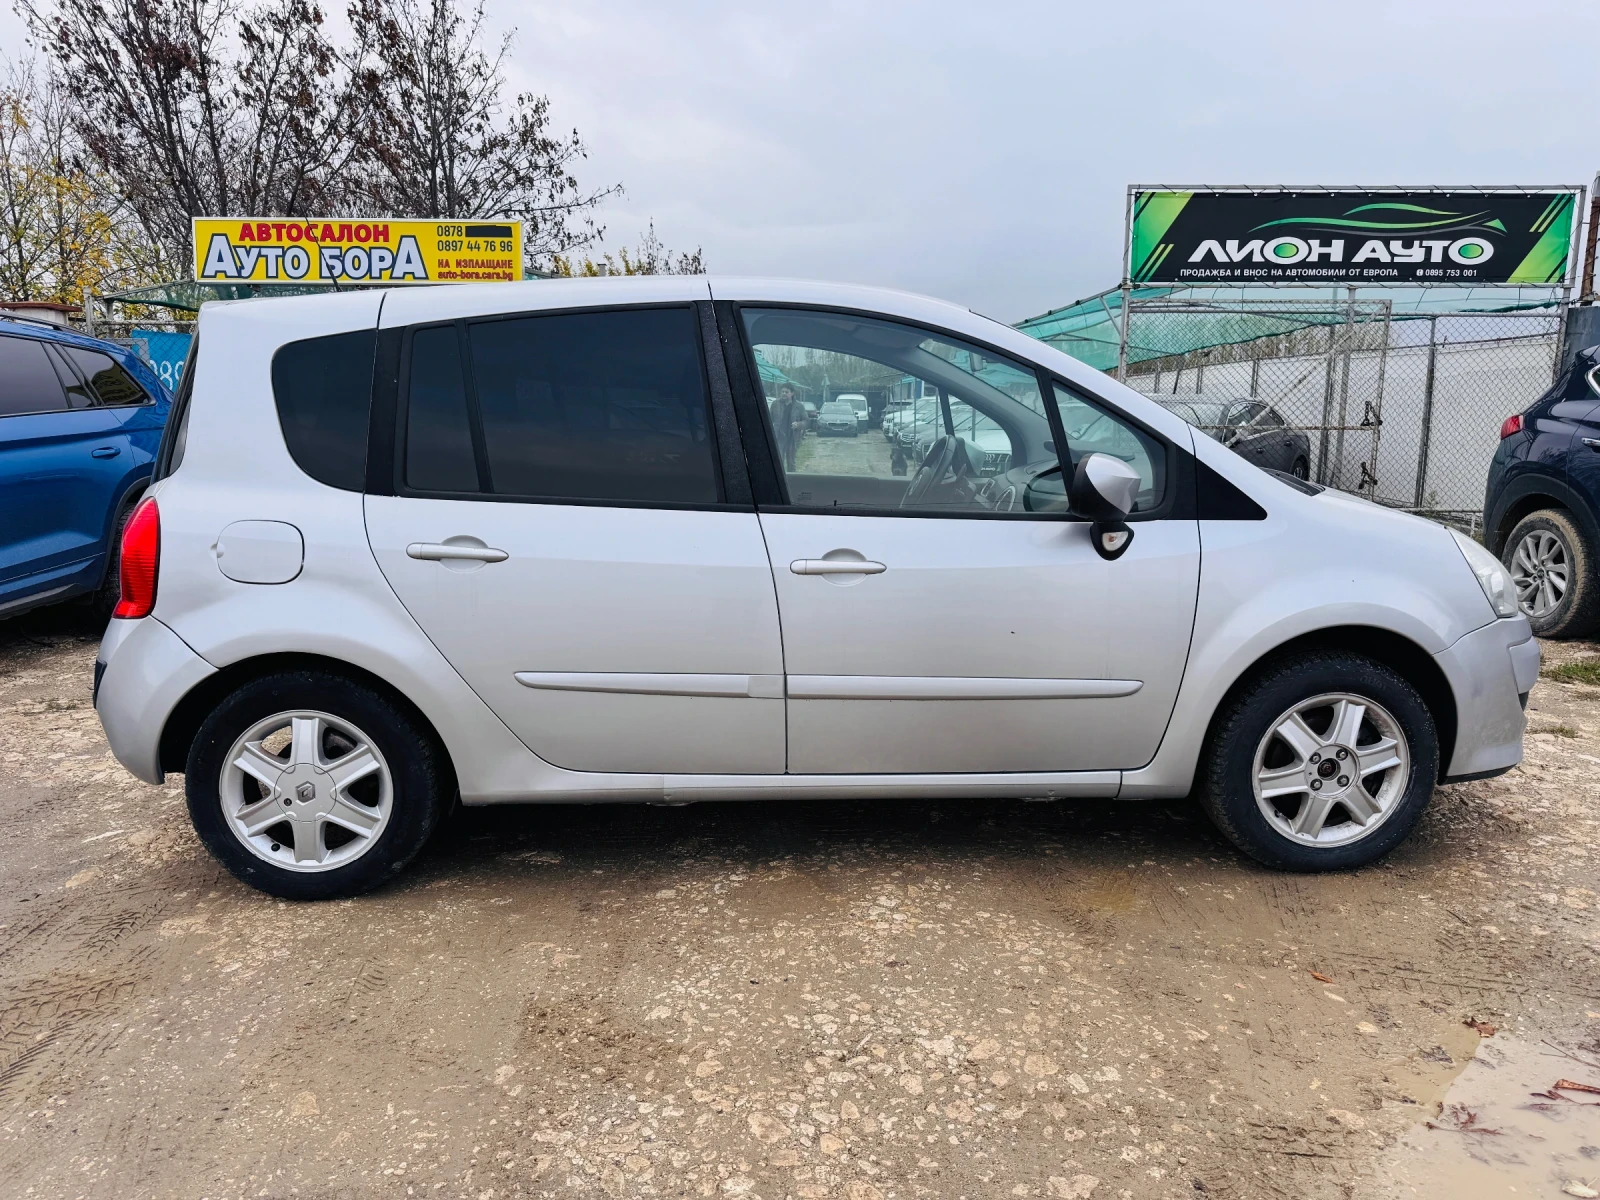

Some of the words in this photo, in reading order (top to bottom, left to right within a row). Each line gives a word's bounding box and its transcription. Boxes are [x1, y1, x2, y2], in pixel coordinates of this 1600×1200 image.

[238, 222, 390, 243] АВТОСАЛОН
[437, 225, 463, 237] 0878
[437, 240, 464, 252] 0897
[466, 240, 481, 252] 44
[483, 240, 496, 252] 76
[499, 240, 513, 252] 96
[1187, 236, 1345, 265] ЛИОН
[1350, 237, 1495, 265] АУТО
[438, 259, 450, 268] НА
[456, 259, 513, 269] ИЗПЛАЩАНЕ
[438, 270, 513, 281] auto-bora.cars.bg
[1180, 268, 1232, 277] ПРОДАЖБА
[1234, 268, 1241, 276] И
[1243, 268, 1269, 276] ВНОС
[1270, 268, 1283, 276] НА
[1285, 268, 1346, 276] АВТОМОБИЛИ
[1348, 268, 1361, 277] ОТ
[1363, 268, 1399, 277] ЕВРОПА
[1425, 269, 1443, 277] 0895
[1445, 269, 1460, 277] 753
[1462, 269, 1477, 277] 001
